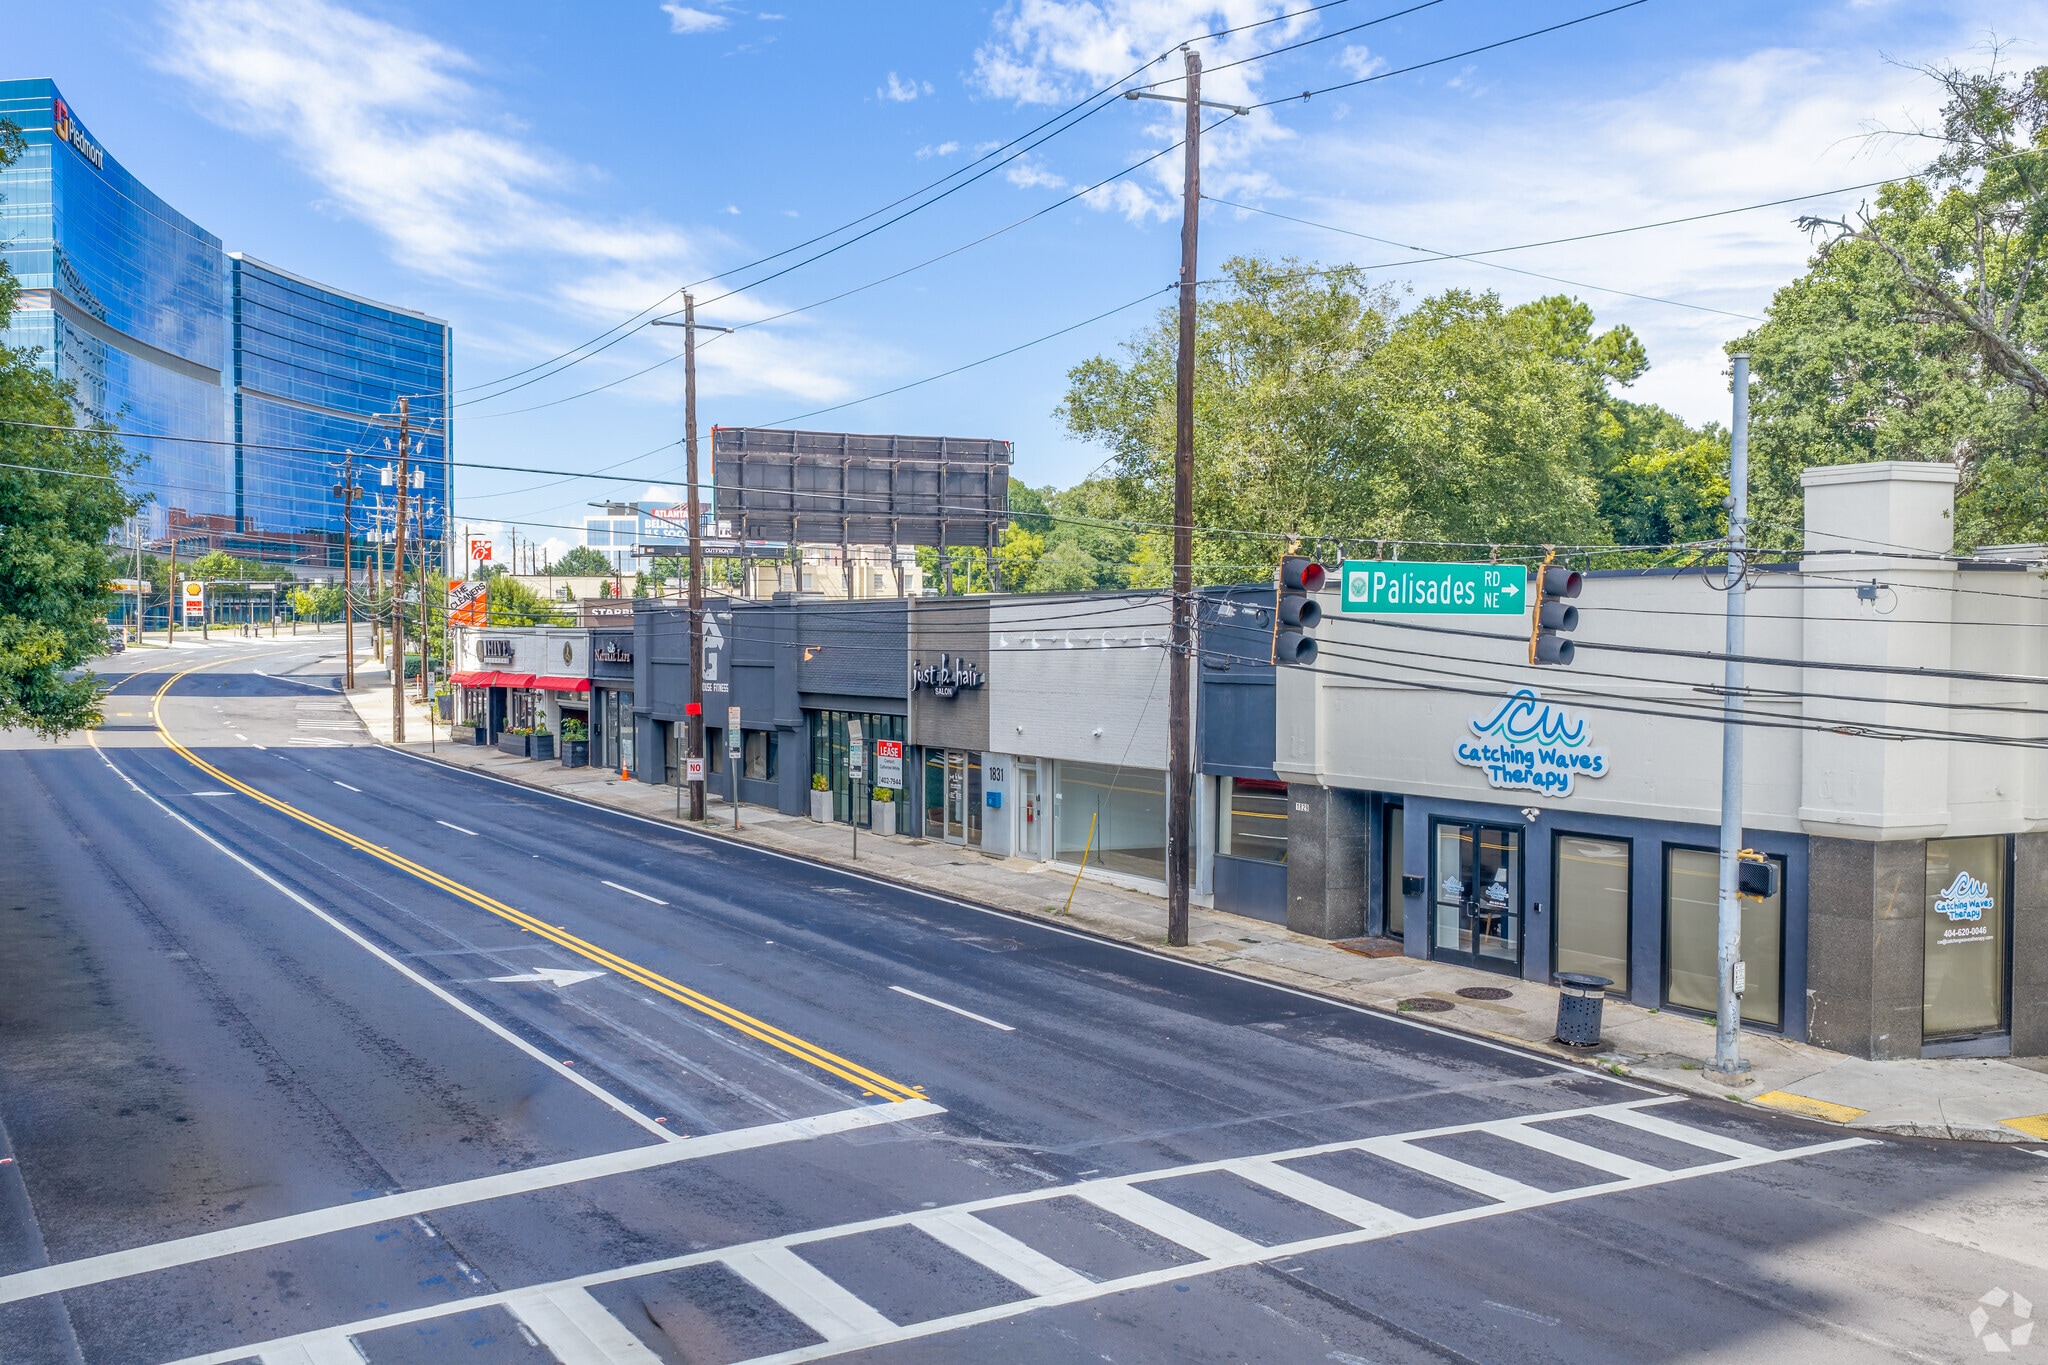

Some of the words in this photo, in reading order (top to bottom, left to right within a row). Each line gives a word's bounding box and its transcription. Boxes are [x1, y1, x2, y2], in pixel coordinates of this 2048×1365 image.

[69, 117, 103, 170] Piedmont
[654, 509, 689, 519] ATLANTA
[644, 519, 686, 529] BELIEVES
[452, 584, 469, 598] THE
[1373, 571, 1475, 605] Palisades
[1484, 571, 1500, 587] RD
[450, 582, 486, 609] CLEANERS
[1484, 592, 1500, 608] NE
[911, 659, 936, 692] just
[956, 658, 978, 687] hair
[934, 687, 952, 696] SALON
[880, 746, 899, 757] LEASE
[1458, 743, 1535, 770] Catching
[1538, 748, 1603, 772] Waves
[690, 763, 701, 772] NO
[989, 767, 1004, 782] 1831
[1488, 764, 1568, 792] Therapy
[1936, 900, 1968, 911] Catching
[1969, 899, 1993, 909] Waves
[1949, 910, 1981, 919] Therapy
[1943, 926, 1987, 937] 404-620-0046
